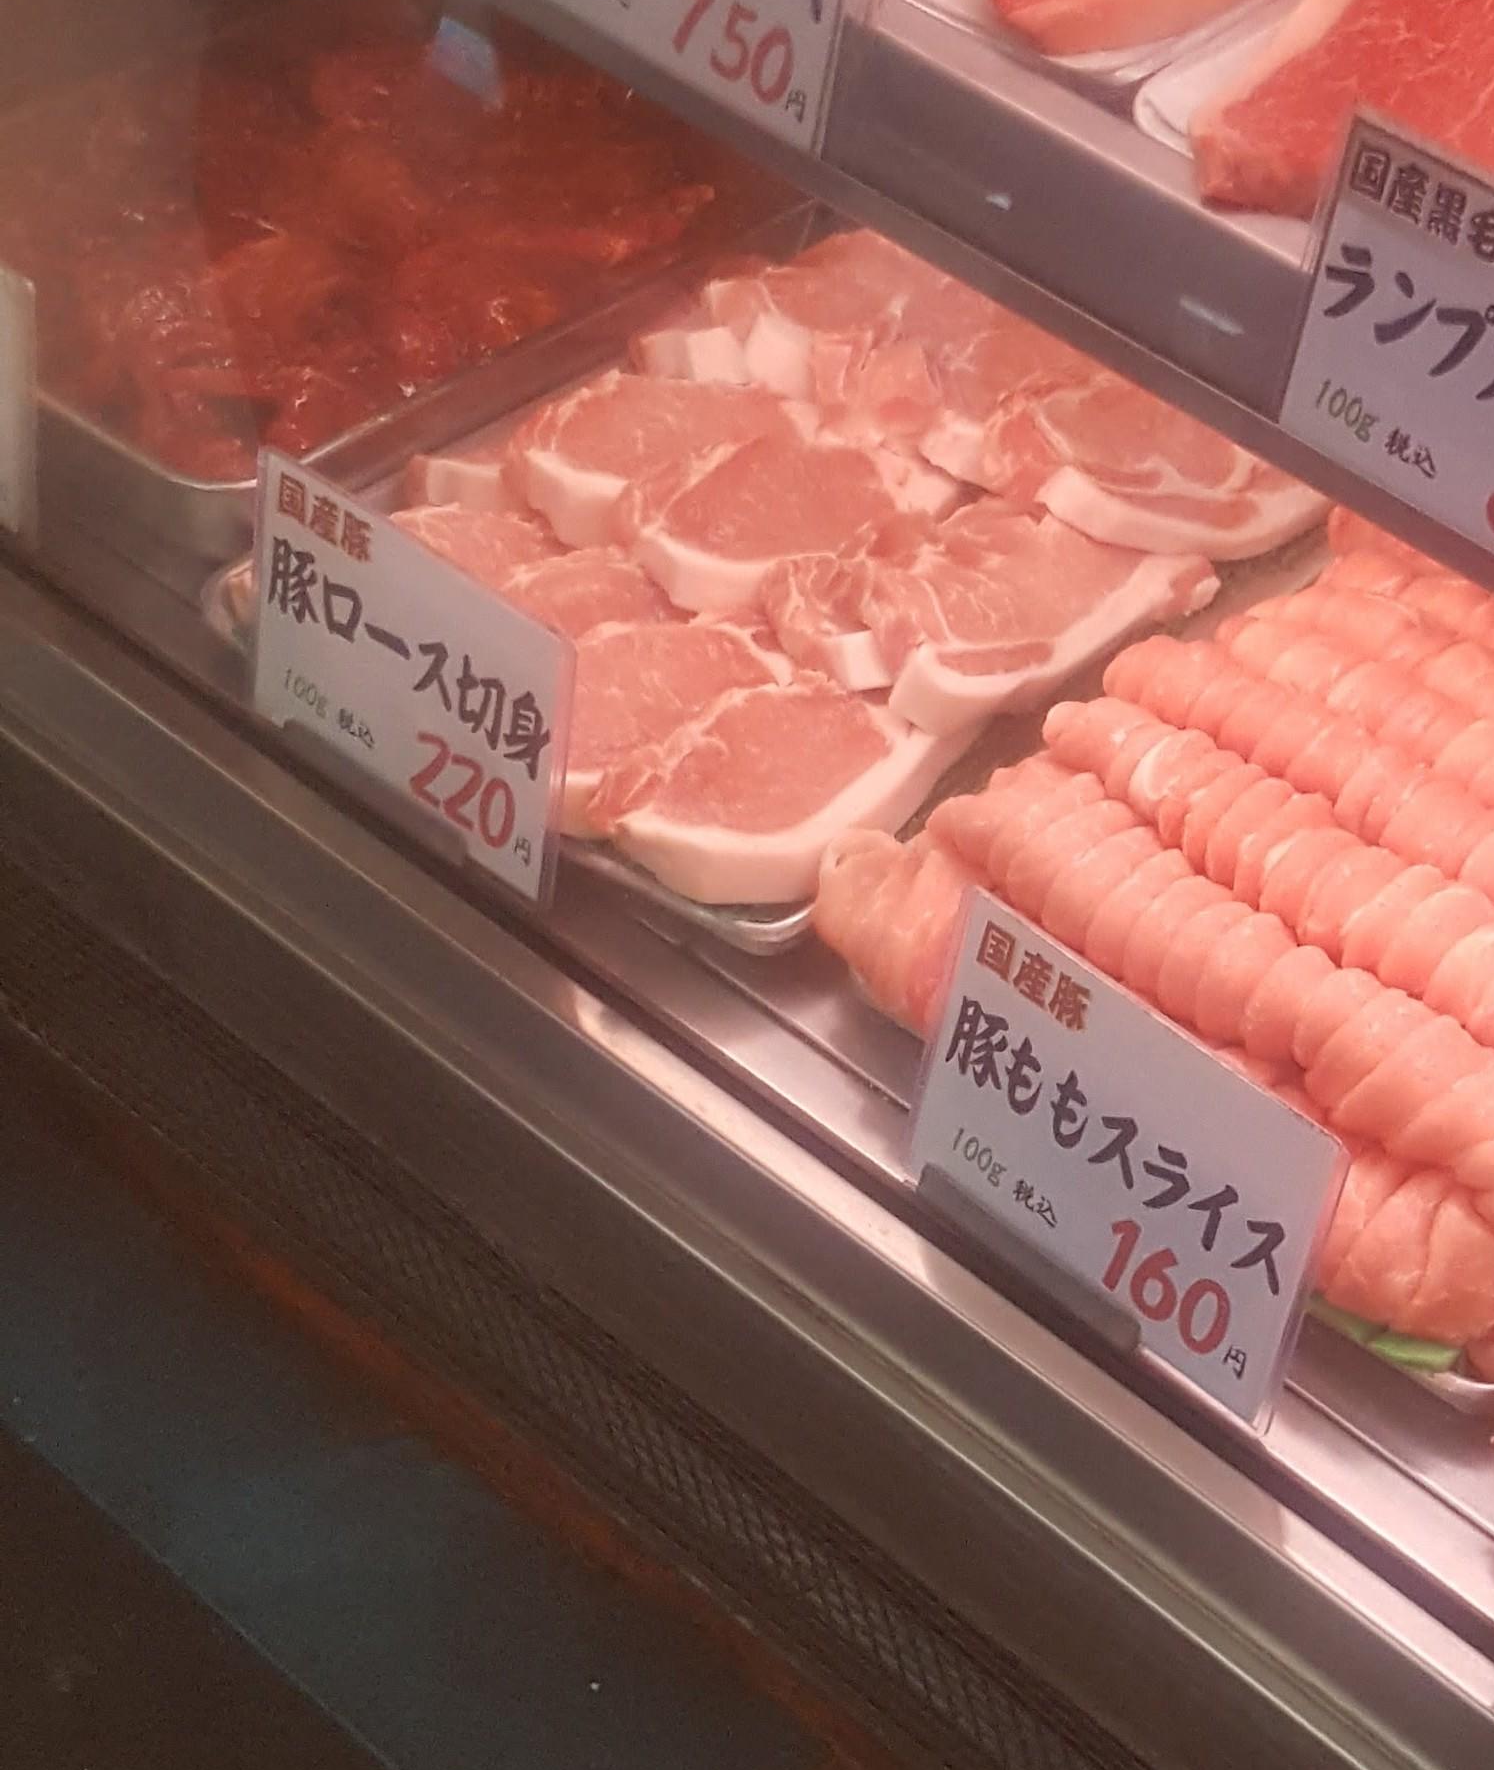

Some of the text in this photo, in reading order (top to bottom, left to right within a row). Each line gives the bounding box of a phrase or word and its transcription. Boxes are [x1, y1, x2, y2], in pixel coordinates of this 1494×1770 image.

[1312, 378, 1437, 481] 100g 税込
[276, 470, 373, 564] 国産豚
[267, 535, 551, 782] 豚ロース切身
[283, 667, 329, 720] 100g
[975, 919, 1092, 1033] 国産豚
[945, 995, 1286, 1297] 豚ももスライス
[951, 1127, 1059, 1228] 100g 税込
